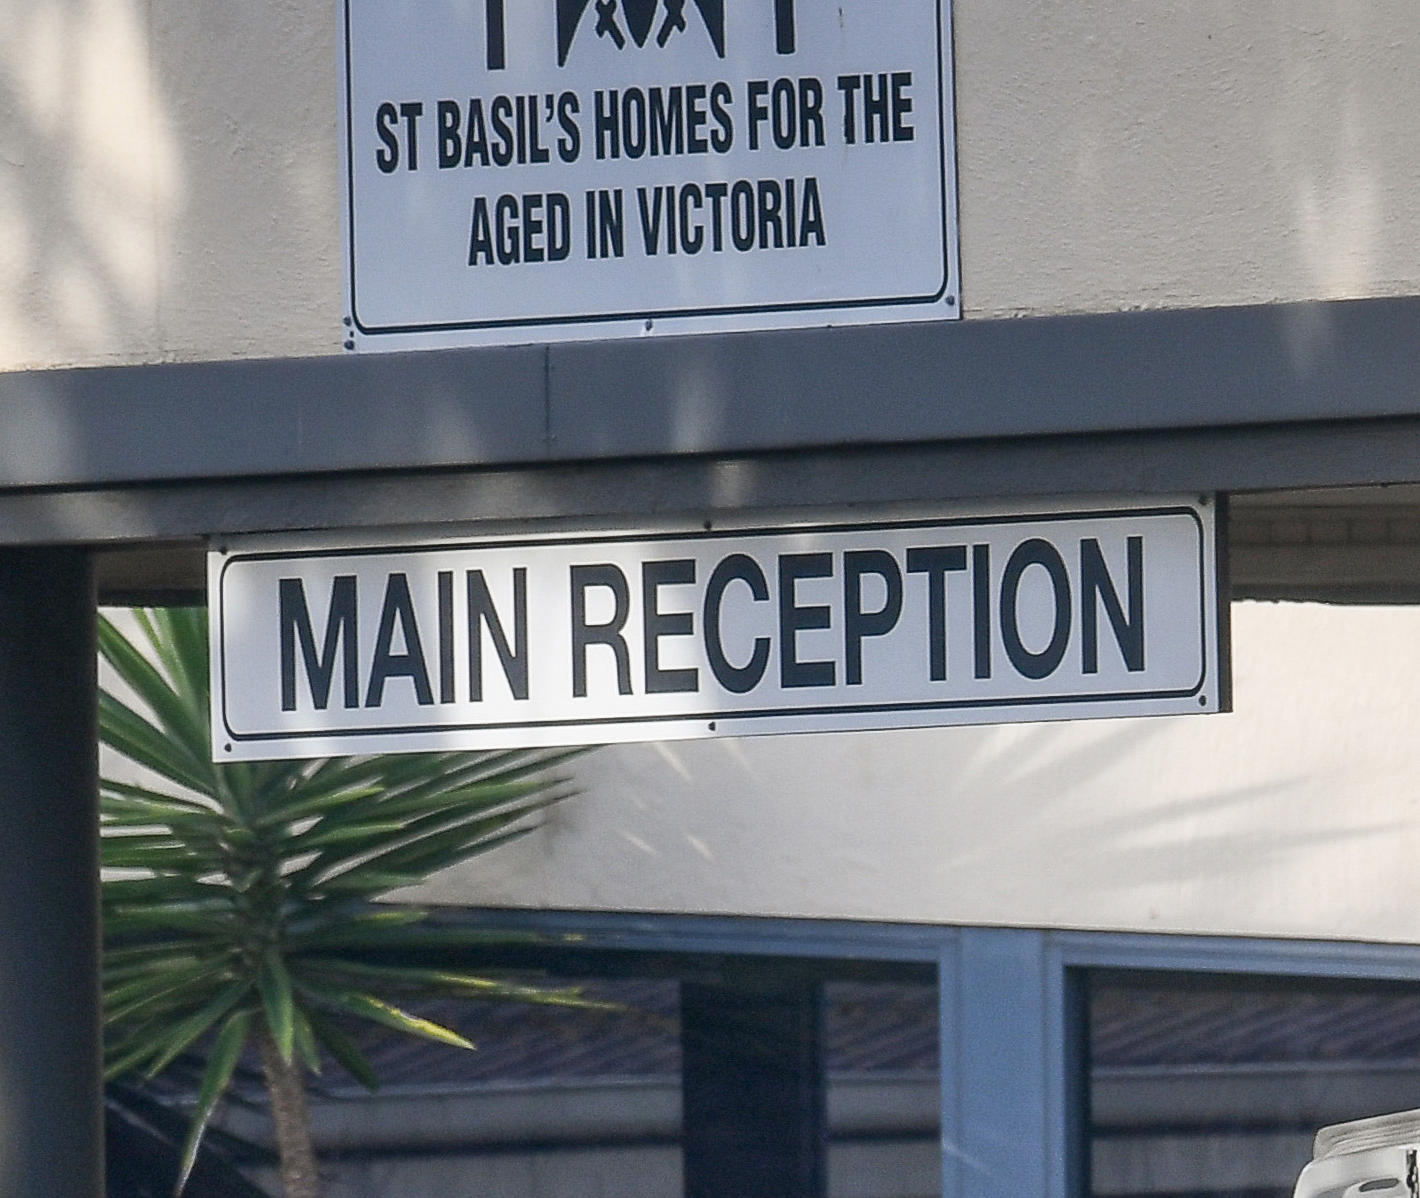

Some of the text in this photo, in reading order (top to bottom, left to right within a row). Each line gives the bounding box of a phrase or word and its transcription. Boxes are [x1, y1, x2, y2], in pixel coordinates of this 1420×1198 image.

[376, 72, 915, 173] ST BASIL'S HOMES FOR THE
[467, 177, 827, 266] AGED IN VICTORIA
[278, 536, 1146, 713] MAIN RECEPTION
